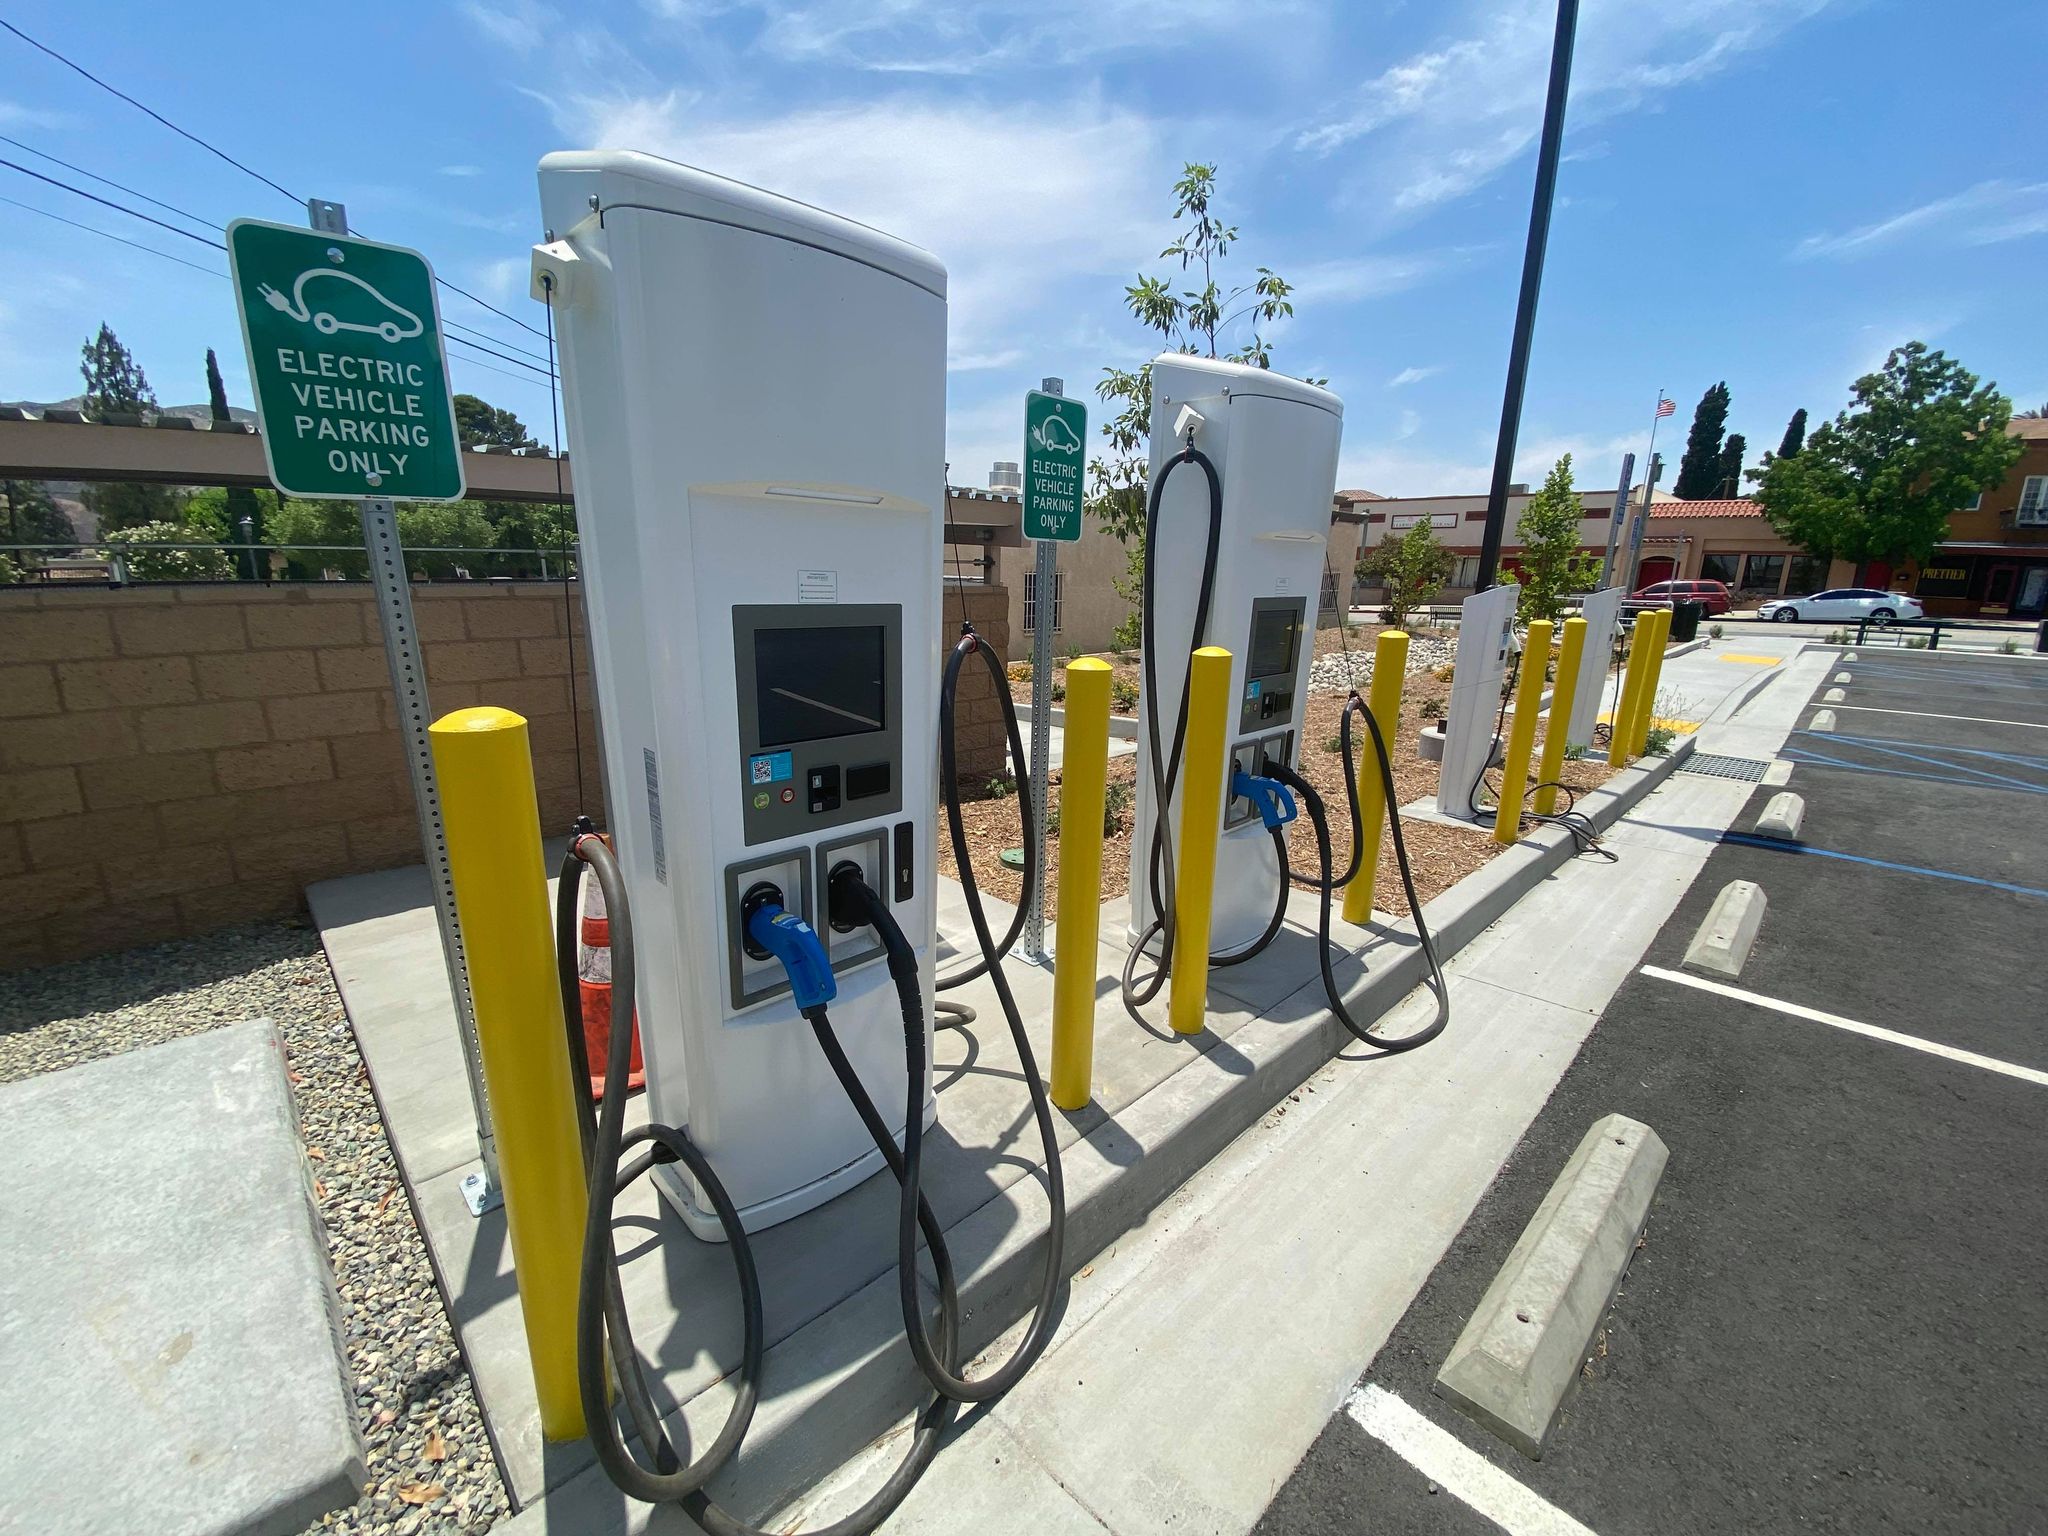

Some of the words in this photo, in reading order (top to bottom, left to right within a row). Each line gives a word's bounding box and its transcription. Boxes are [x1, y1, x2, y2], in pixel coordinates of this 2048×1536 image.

[277, 348, 424, 386] ELECTRIC
[291, 382, 424, 417] VEHICLE
[294, 415, 430, 448] PARKING
[328, 449, 409, 476] ONLY
[1033, 460, 1077, 478] ELECTRIC
[1035, 478, 1074, 495] VEHICLE
[1033, 496, 1074, 512] PARKING
[1041, 515, 1066, 528] ONLY
[1921, 568, 1967, 580] PRETTIER
